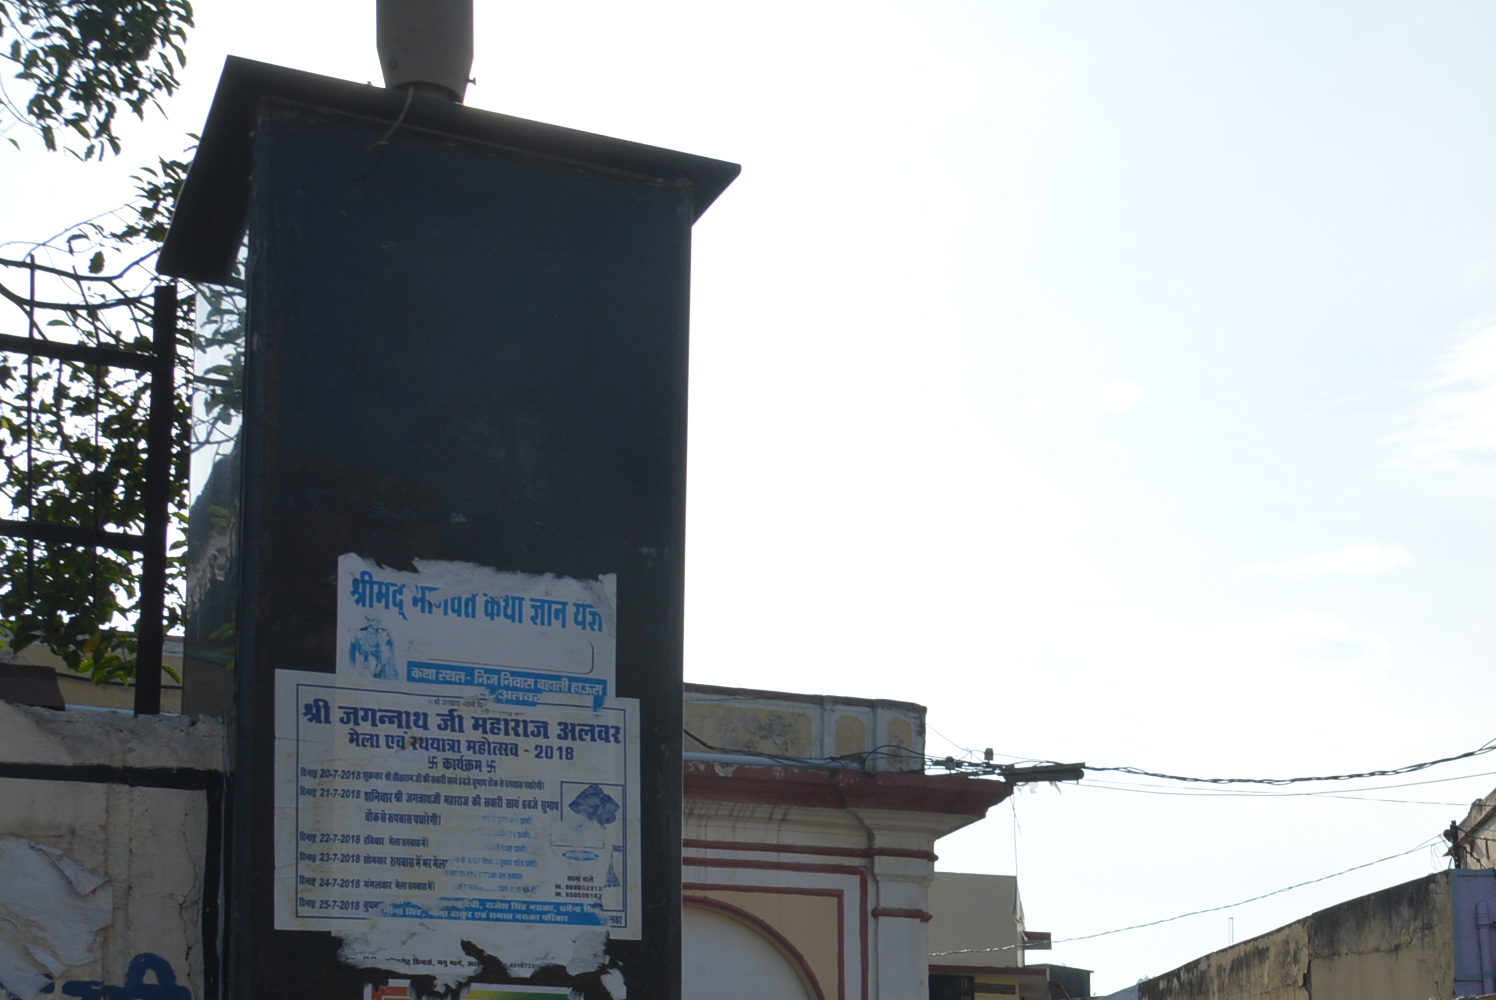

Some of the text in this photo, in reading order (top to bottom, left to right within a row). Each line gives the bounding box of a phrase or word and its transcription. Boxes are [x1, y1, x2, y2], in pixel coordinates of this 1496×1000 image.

[530, 597, 568, 628] ज्ञान
[302, 698, 622, 744] श्री जगन्नाथ जी महाराज अलवर
[348, 728, 380, 749] मेला
[534, 745, 574, 762] 2018
[319, 768, 361, 780] 20-7-2018
[319, 788, 361, 800] 21-7-2018
[319, 833, 361, 844] 22-7-2018
[319, 852, 361, 864] 23-7-2018
[319, 877, 360, 889] 24-7-2018
[319, 899, 360, 911] 25-7-2018
